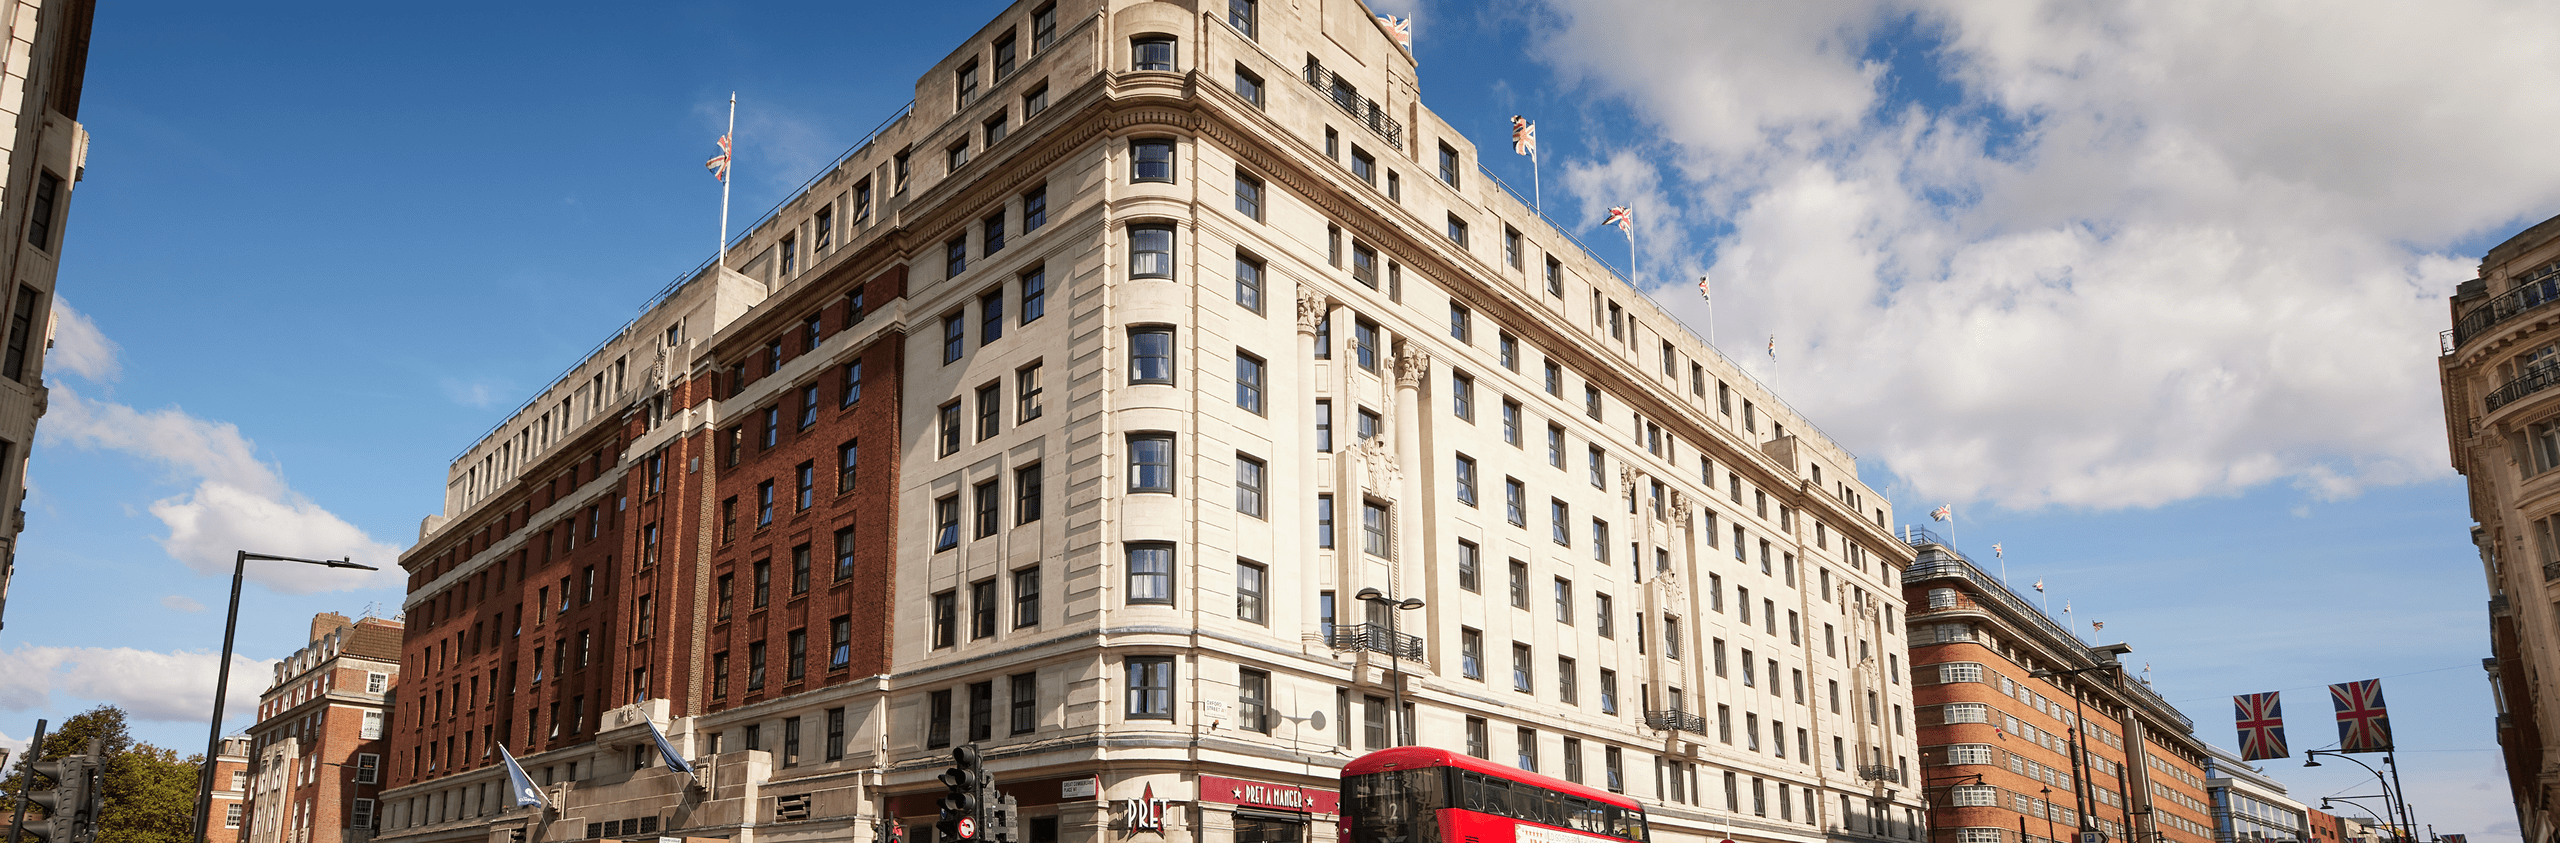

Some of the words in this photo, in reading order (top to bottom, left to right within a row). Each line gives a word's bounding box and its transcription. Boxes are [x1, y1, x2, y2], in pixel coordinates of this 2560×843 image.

[1245, 784, 1264, 804] PRET
[1265, 787, 1271, 805] A
[1273, 788, 1302, 808] MANGER
[1128, 797, 1169, 828] PRET
